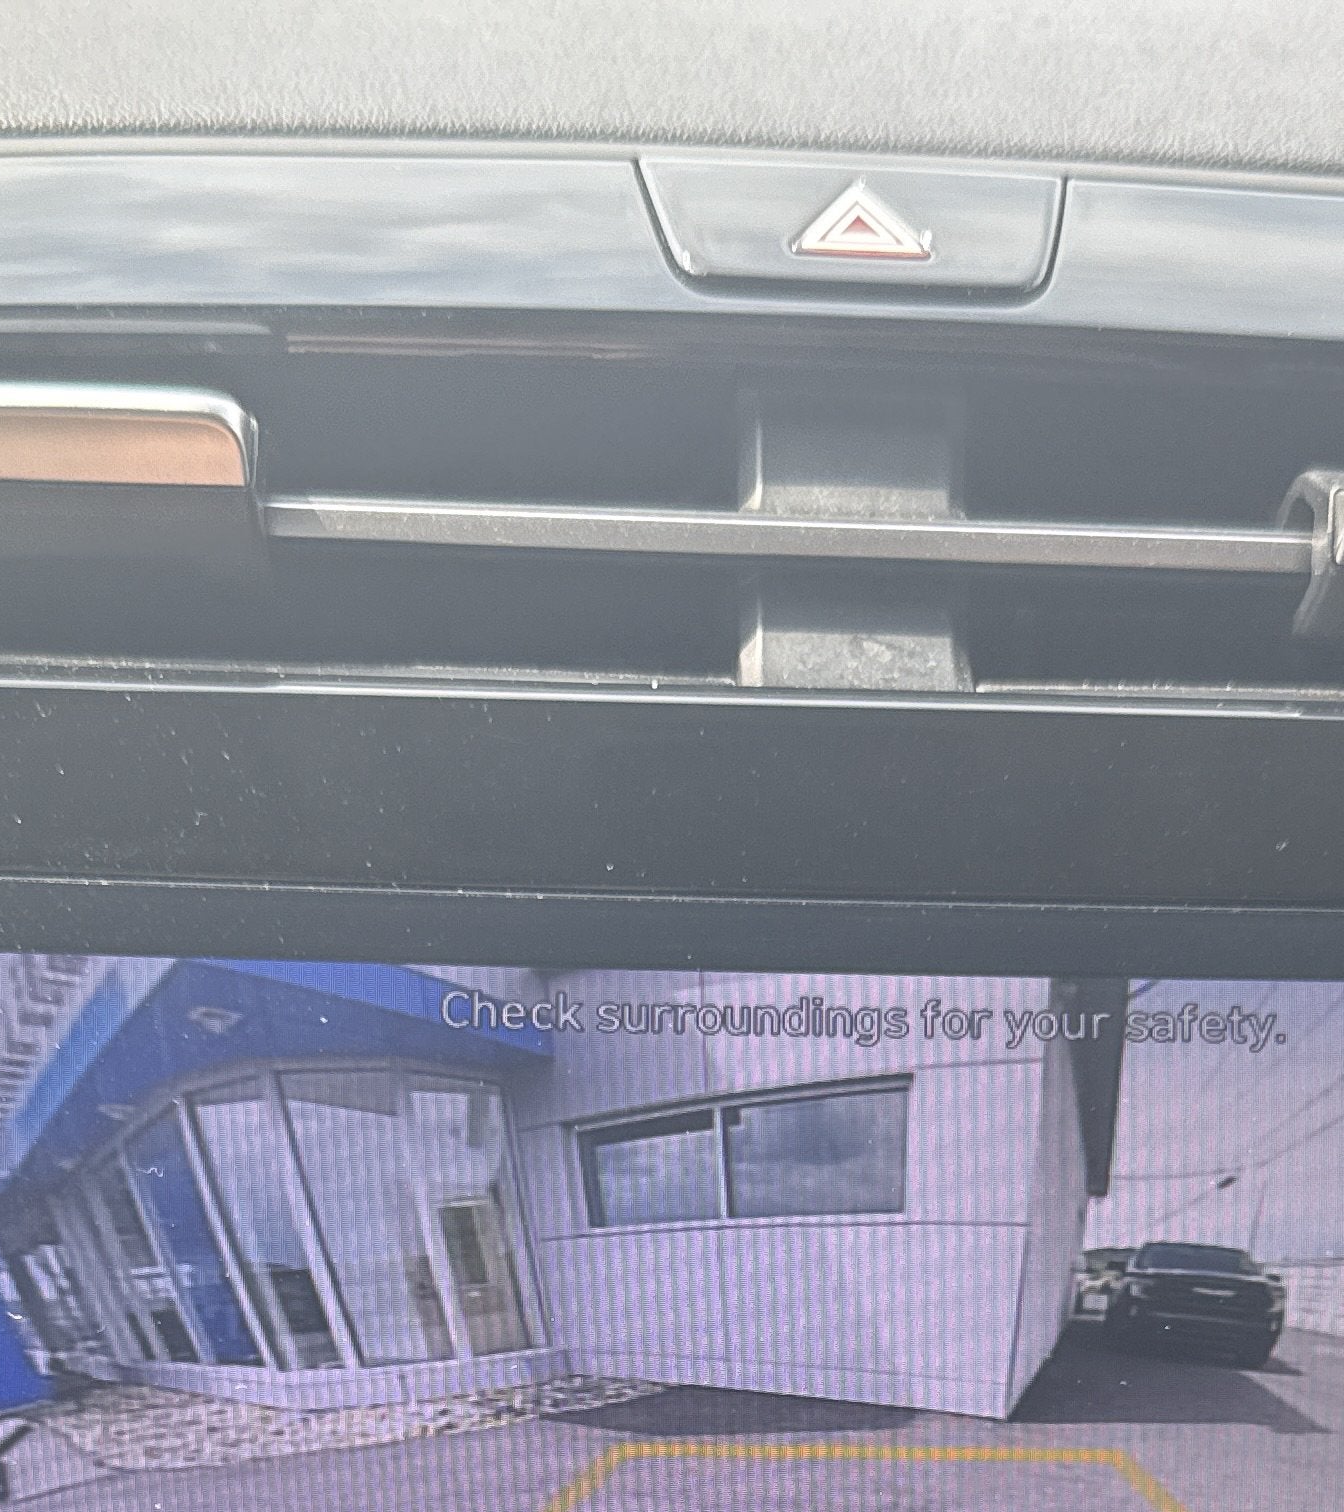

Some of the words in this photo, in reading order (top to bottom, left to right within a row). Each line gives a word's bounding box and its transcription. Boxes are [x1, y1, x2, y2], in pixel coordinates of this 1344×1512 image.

[441, 989, 583, 1033] Check
[596, 998, 911, 1047] surroundings
[921, 999, 993, 1042] for
[1003, 1006, 1112, 1049] your
[1124, 1003, 1287, 1053] safety.
